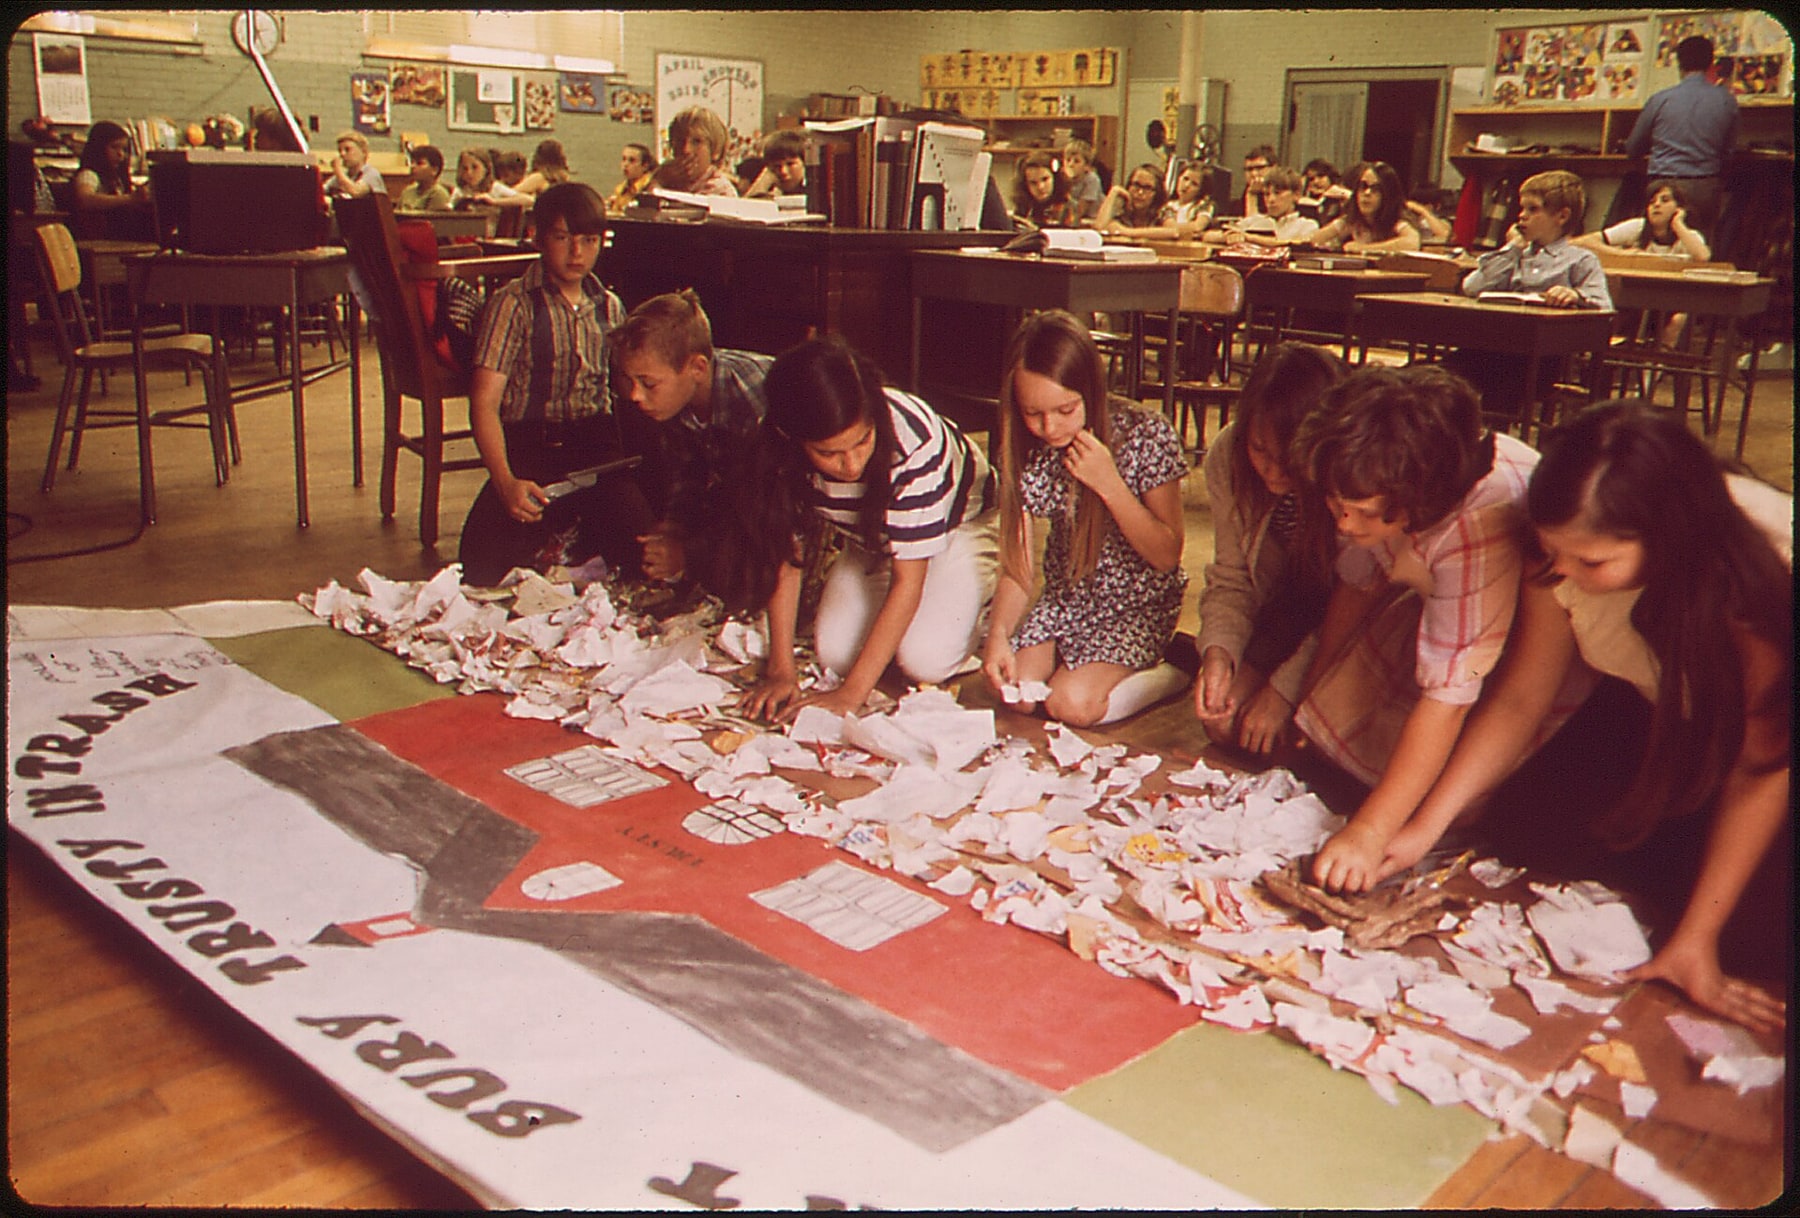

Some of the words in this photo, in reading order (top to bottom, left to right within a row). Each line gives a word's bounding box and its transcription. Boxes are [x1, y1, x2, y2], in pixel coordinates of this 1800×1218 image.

[664, 59, 704, 75] APRIL
[14, 673, 200, 781] TRASH
[24, 783, 107, 818] IN
[56, 838, 308, 985] TRUSTY
[296, 1015, 583, 1138] BURY
